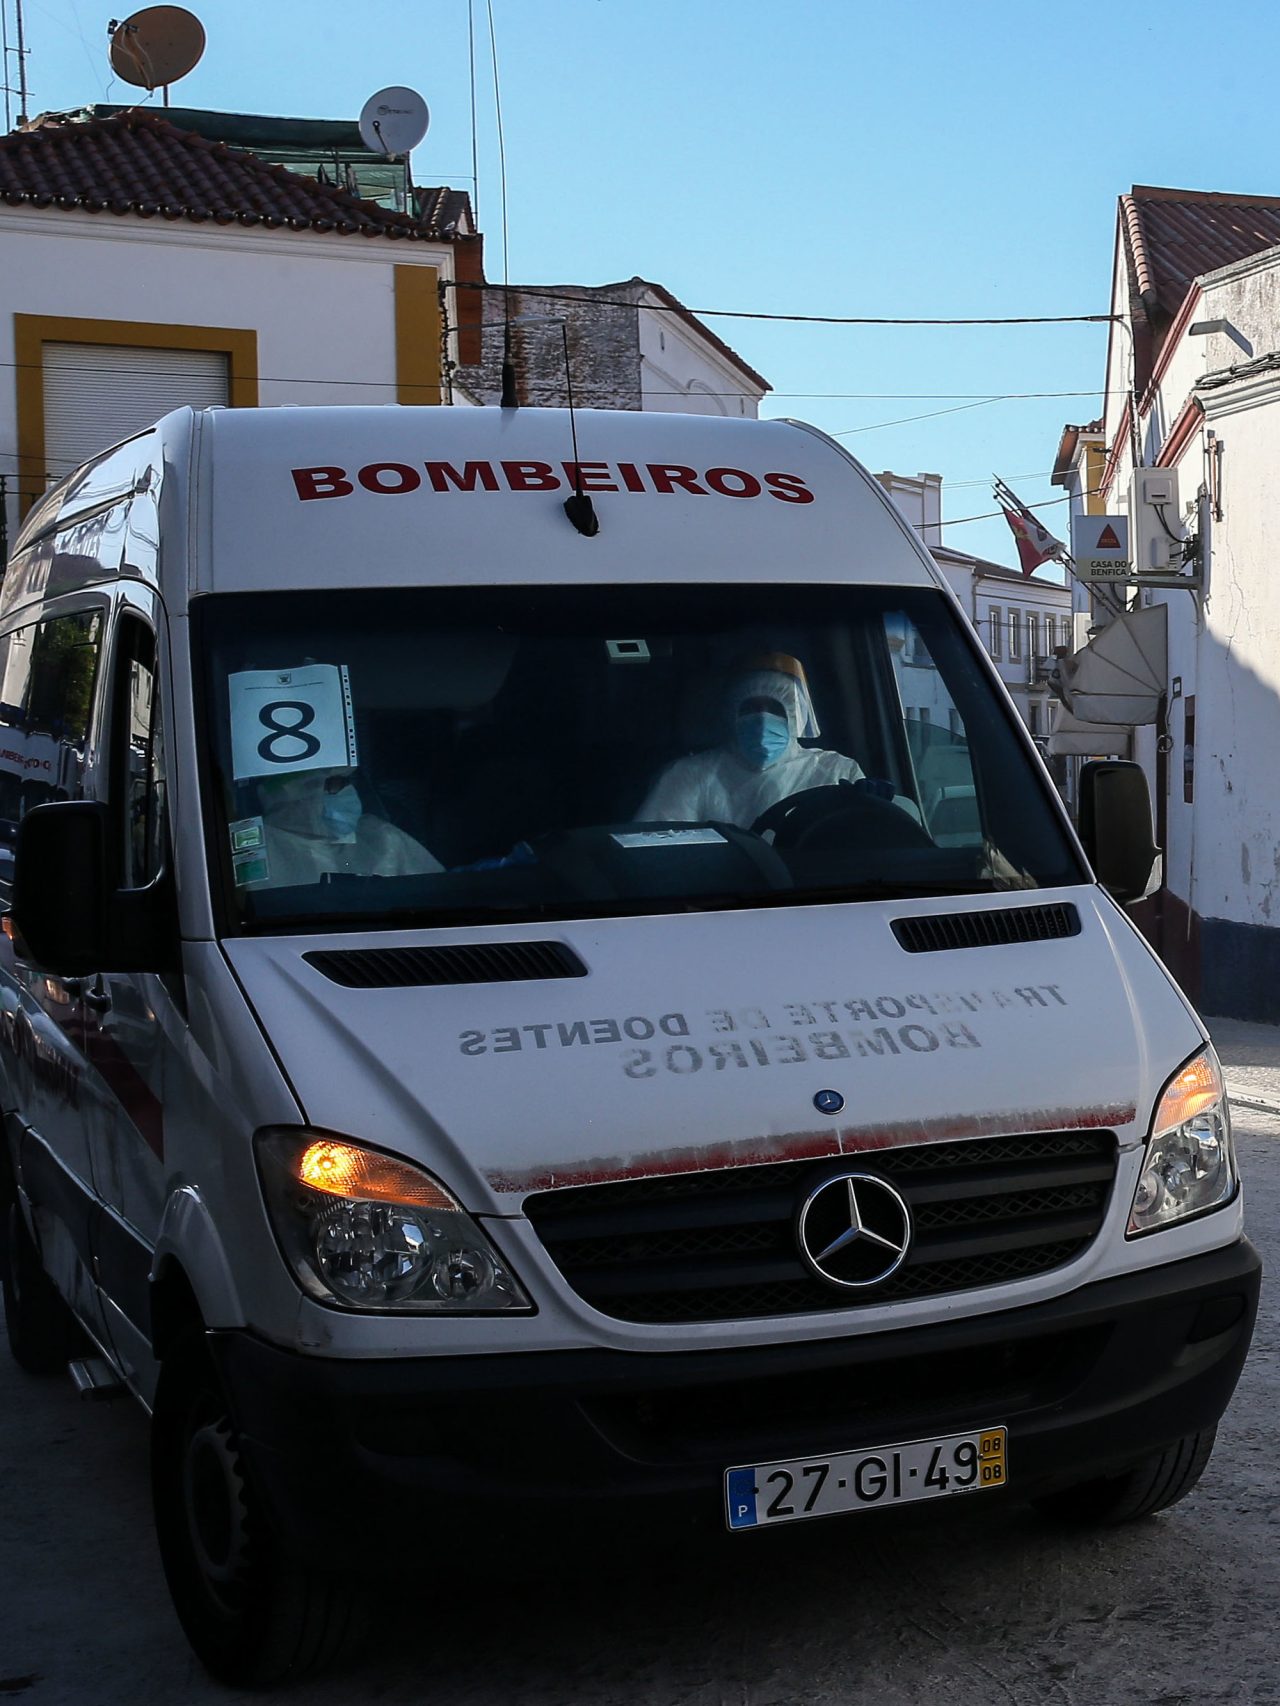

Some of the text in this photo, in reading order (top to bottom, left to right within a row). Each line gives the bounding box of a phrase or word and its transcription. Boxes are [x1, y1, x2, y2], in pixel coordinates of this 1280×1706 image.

[291, 461, 815, 504] BOMBEIROS
[258, 701, 320, 763] 8
[983, 1437, 1001, 1452] 08
[983, 1464, 1002, 1480] 08
[738, 1505, 748, 1517] P
